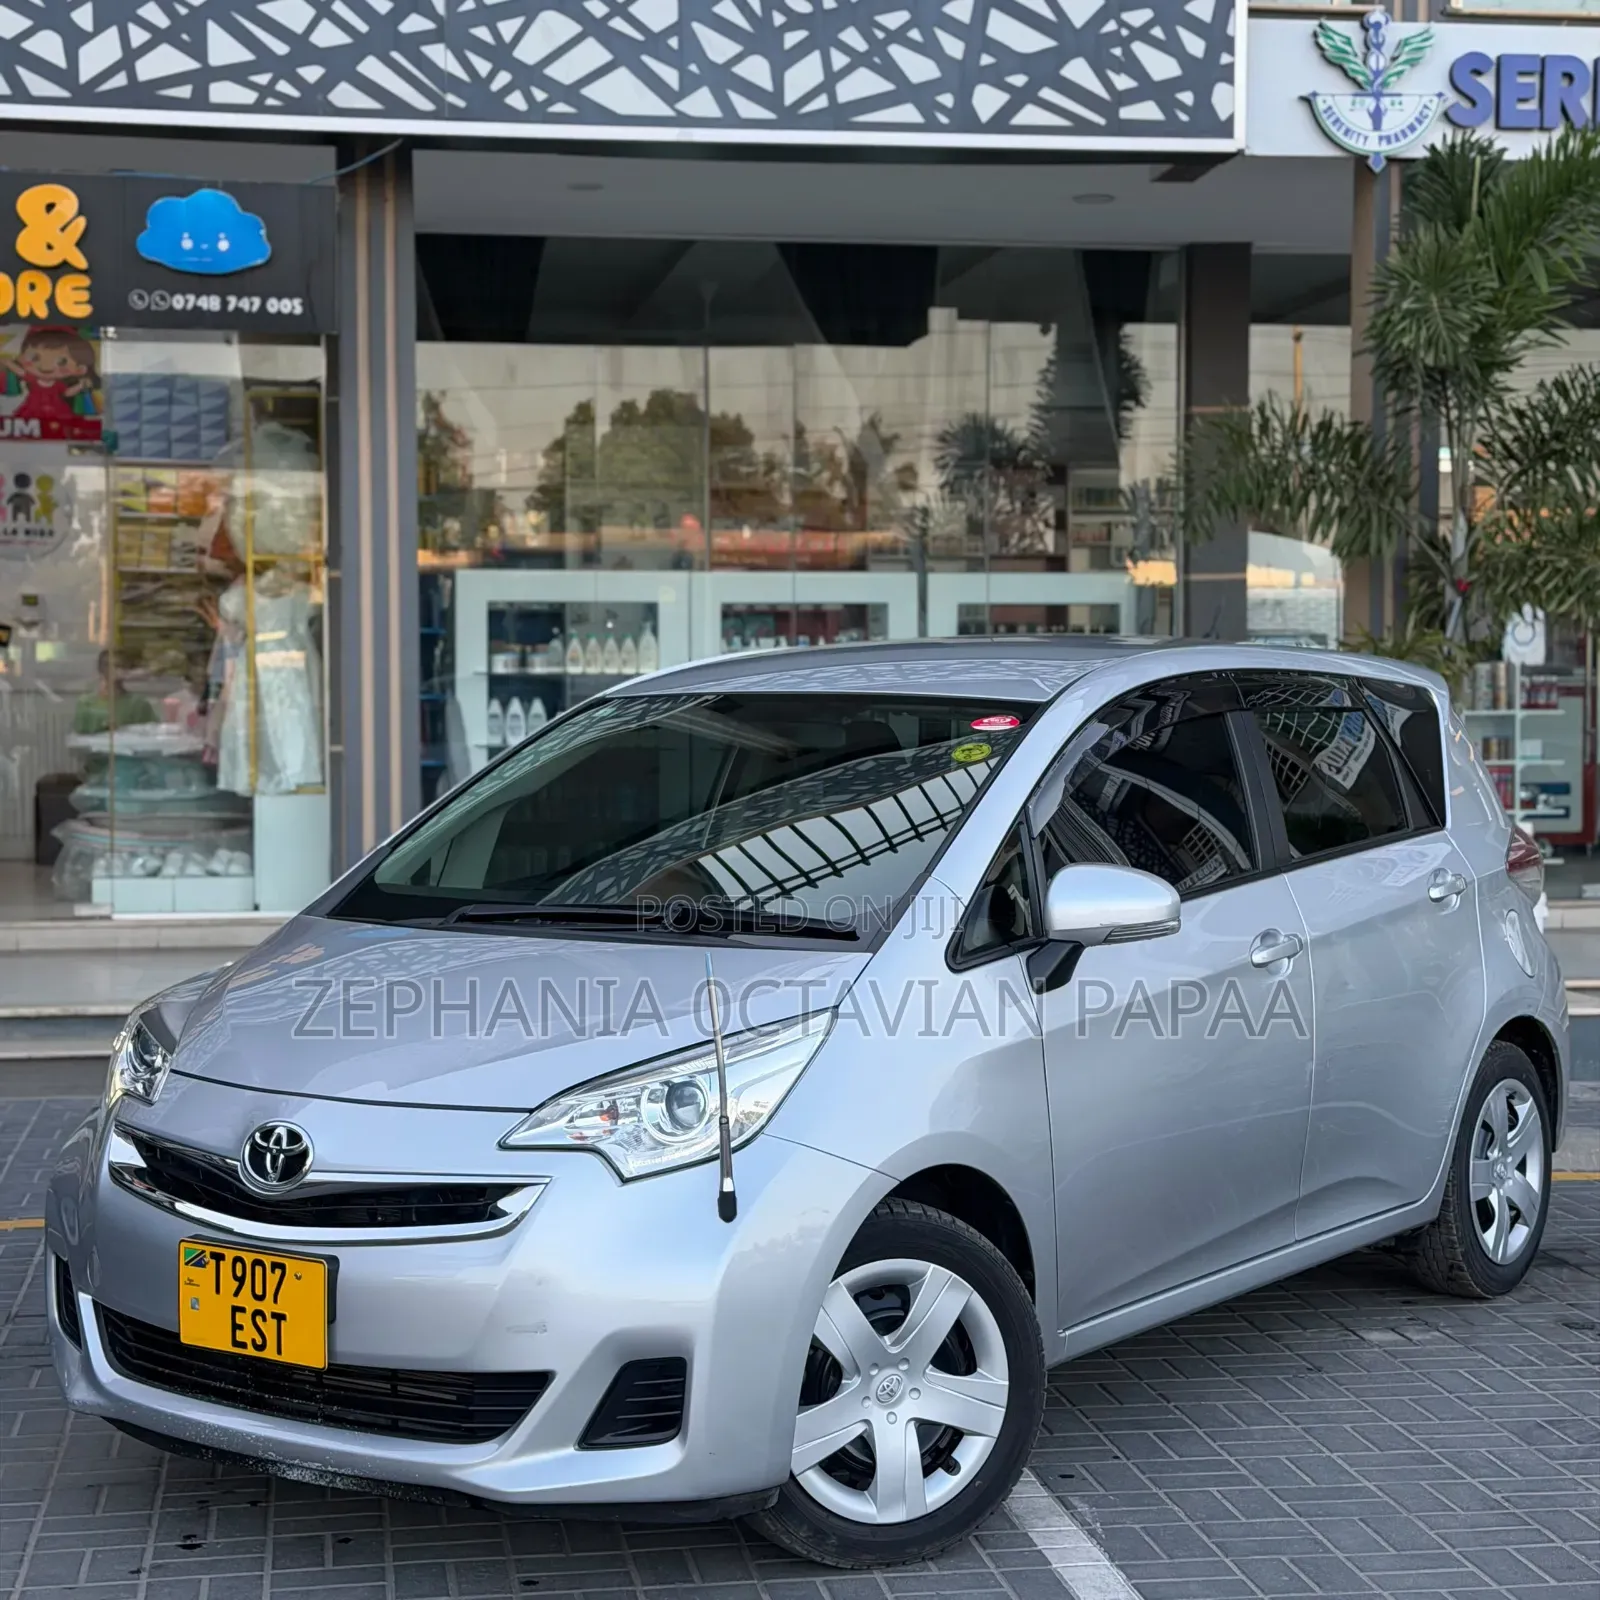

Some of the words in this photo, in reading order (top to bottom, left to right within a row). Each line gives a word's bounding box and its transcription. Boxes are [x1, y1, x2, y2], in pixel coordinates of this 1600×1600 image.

[1447, 51, 1600, 130] SER
[1377, 103, 1433, 147] PHARMACY
[15, 184, 88, 270] &
[171, 293, 221, 313] 0748
[225, 294, 262, 313] 747
[265, 296, 304, 316] 005
[210, 1250, 286, 1305] T907
[231, 1304, 287, 1356] EST
